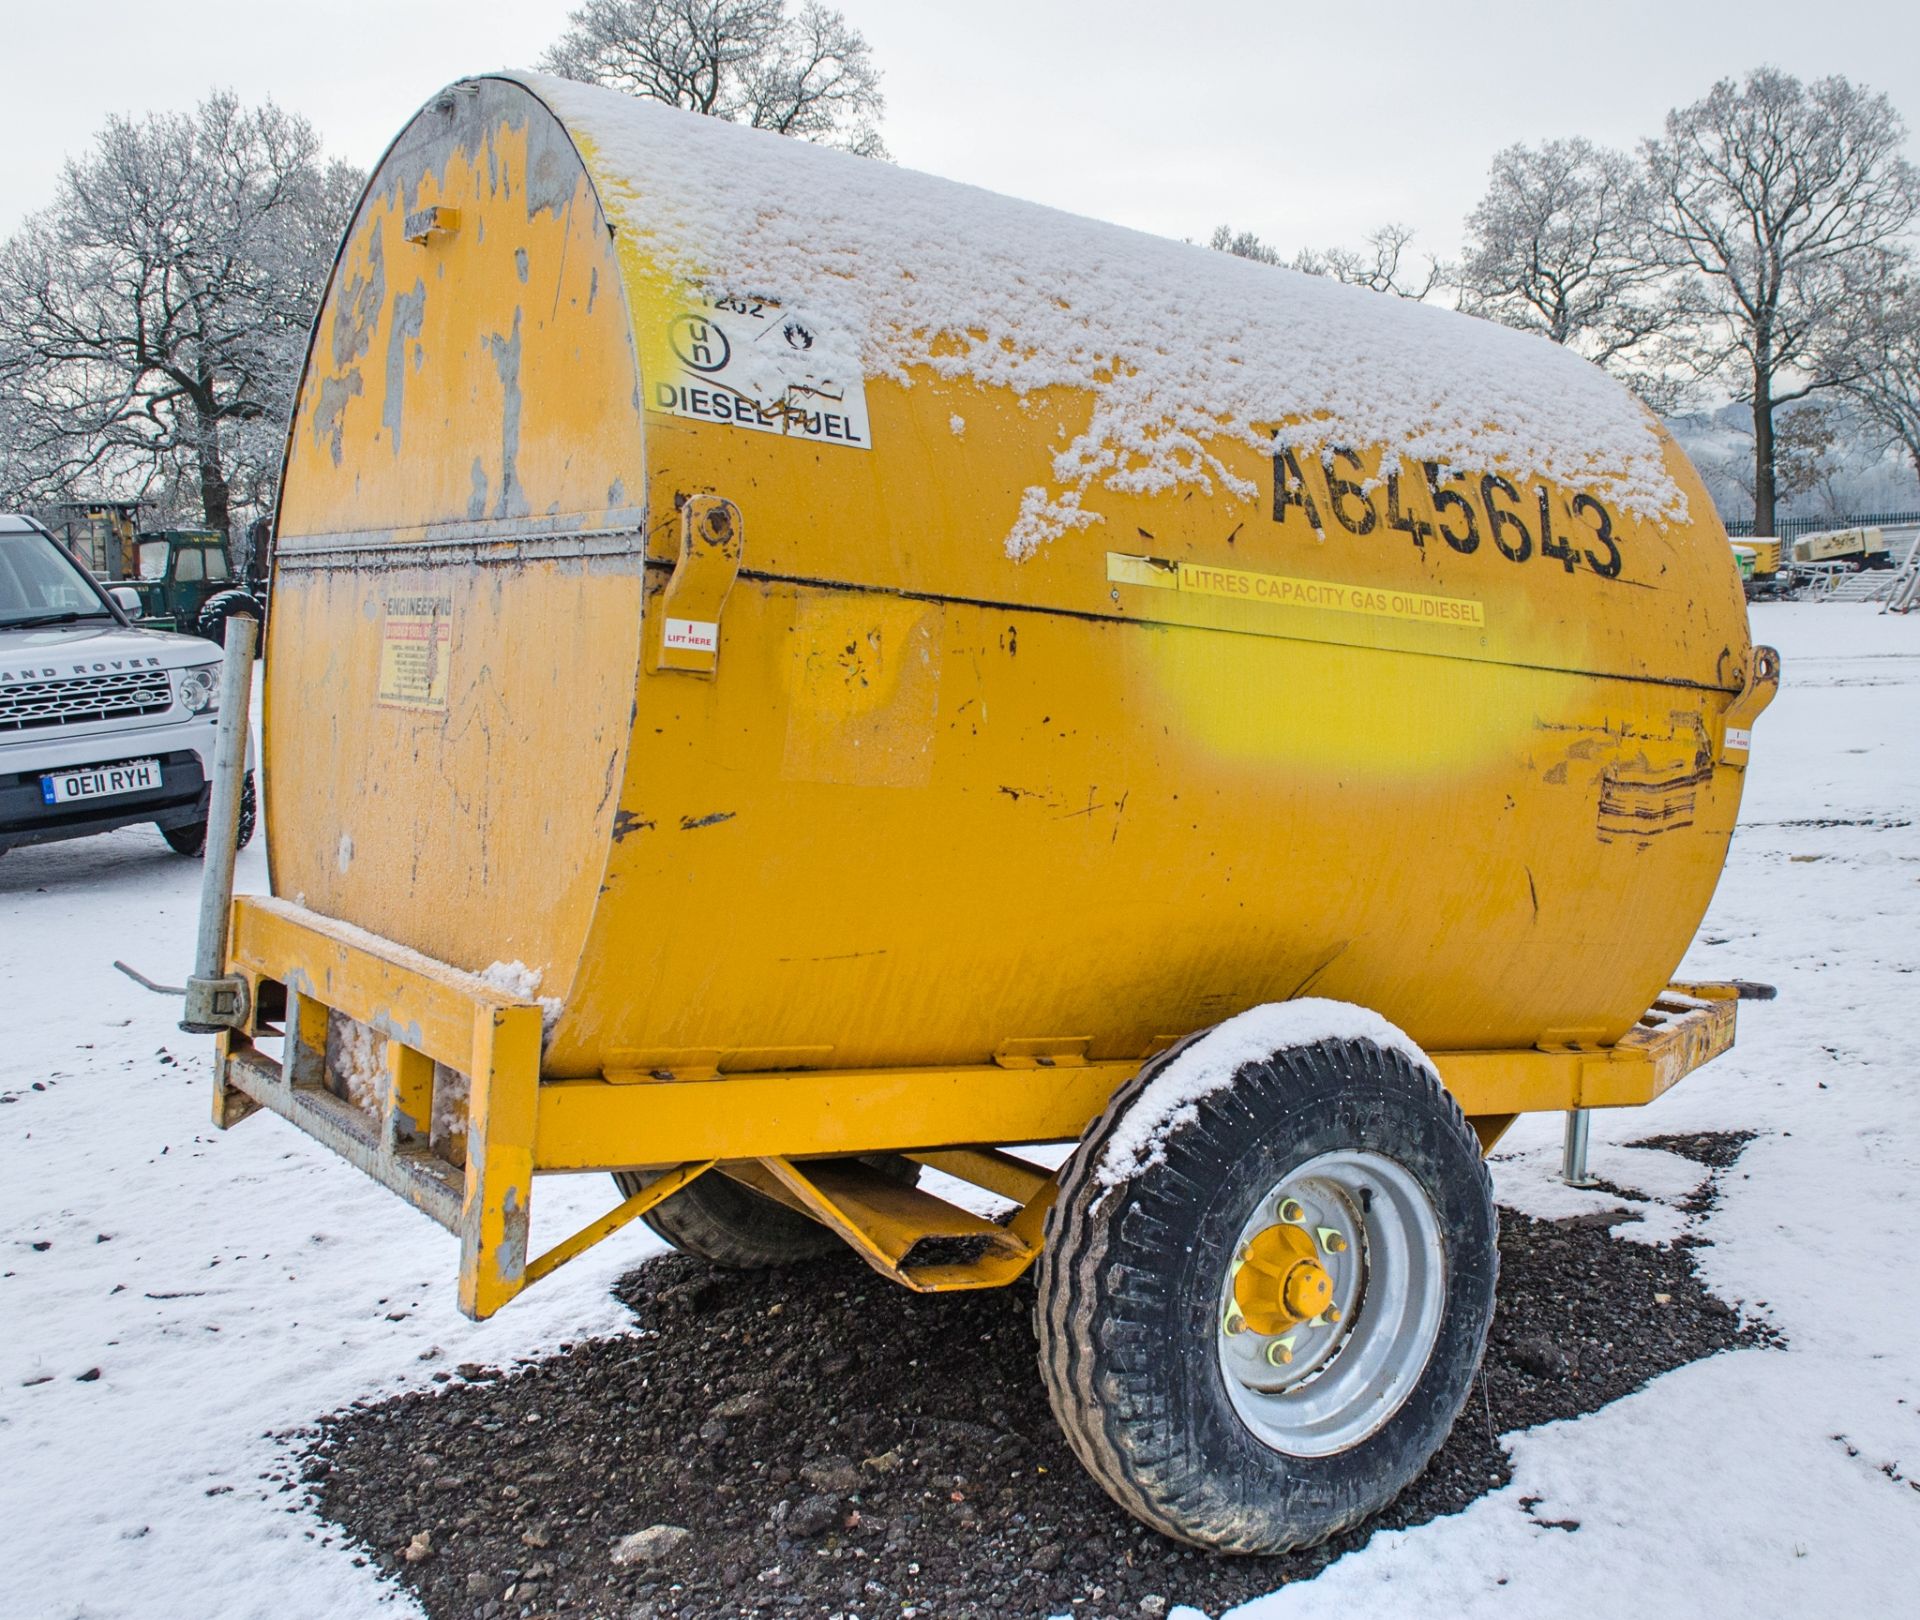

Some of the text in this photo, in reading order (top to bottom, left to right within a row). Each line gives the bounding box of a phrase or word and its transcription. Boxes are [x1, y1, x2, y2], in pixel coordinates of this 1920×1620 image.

[656, 382, 861, 442] DIESEL FUEL
[1272, 430, 1622, 579] A645643
[386, 597, 451, 616] ENGINEERNG
[1184, 568, 1481, 622] LITRES CAPACITY GAS OIL/DIESEL
[667, 635, 712, 646] LIFT HERE
[72, 657, 161, 675] ROVER
[110, 767, 151, 790] RYH
